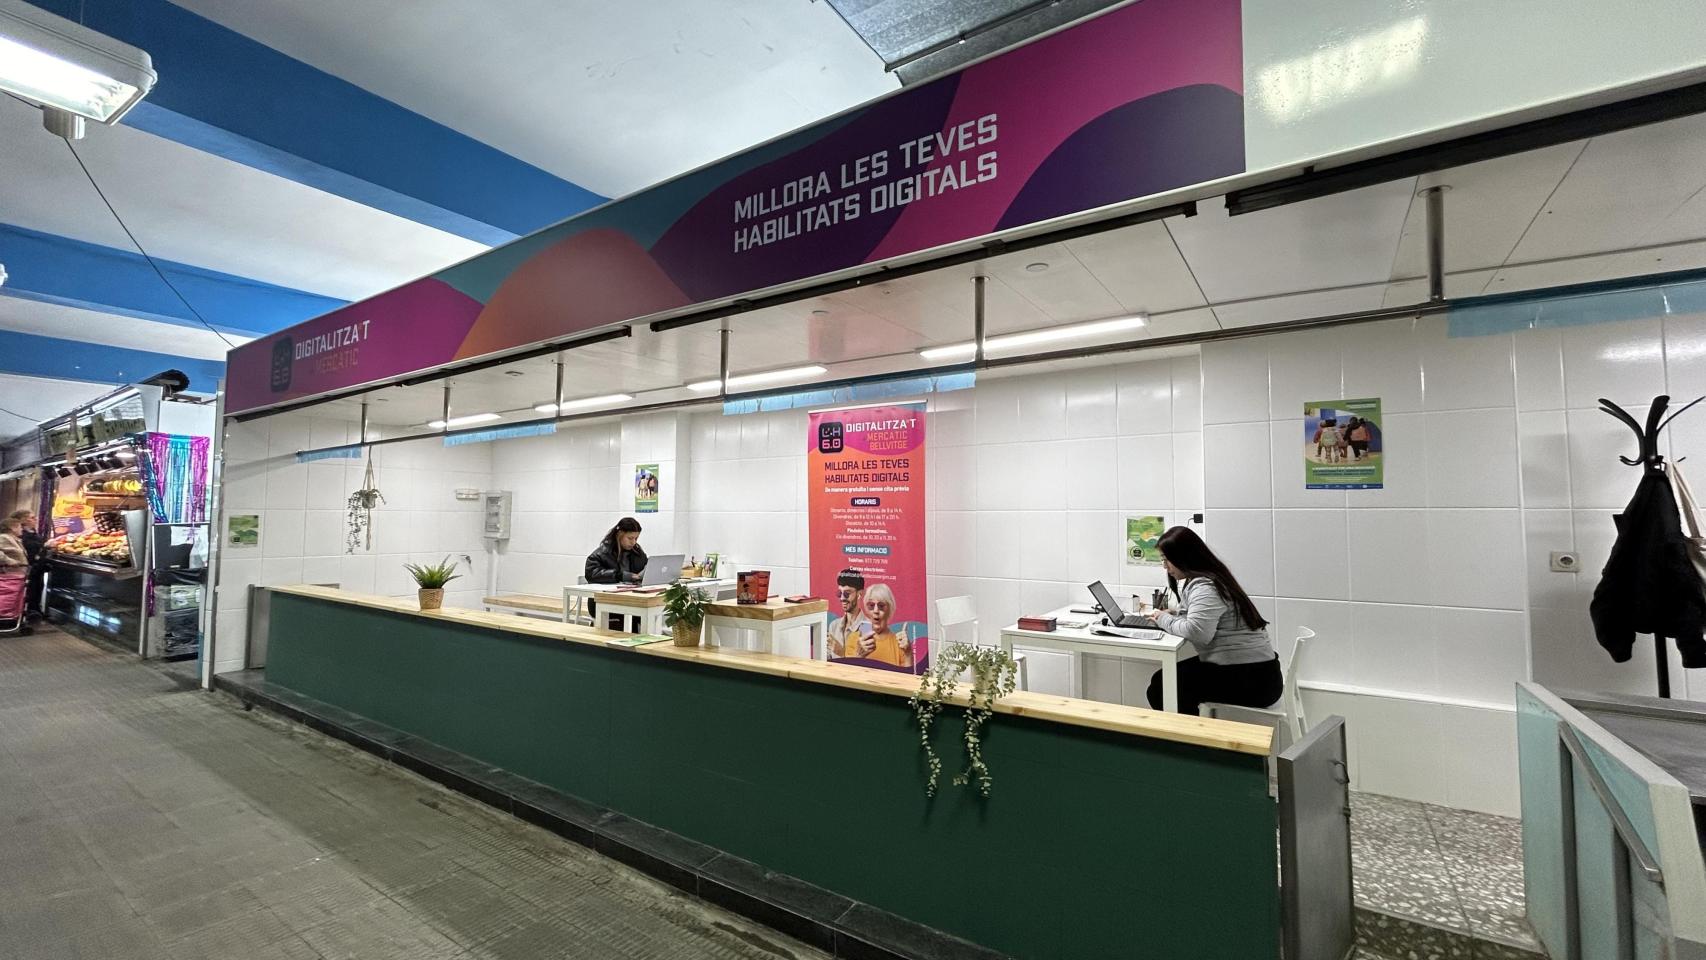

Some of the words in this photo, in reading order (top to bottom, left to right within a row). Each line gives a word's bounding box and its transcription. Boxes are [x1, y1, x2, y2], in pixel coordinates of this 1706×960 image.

[734, 171, 831, 223] MILLORA
[841, 150, 888, 189] LES
[900, 113, 997, 169] TEVES
[734, 193, 860, 253] HABILITATS
[870, 151, 997, 214] DIGITALS
[867, 430, 908, 441] MERCATIC
[822, 438, 841, 449] 6.0
[869, 440, 907, 451] BELLVITGE
[824, 461, 859, 471] MILLORA
[861, 460, 877, 470] LES
[880, 458, 909, 469] TEVES
[824, 473, 869, 484] HABILITATS
[872, 472, 910, 482] DIGITALS
